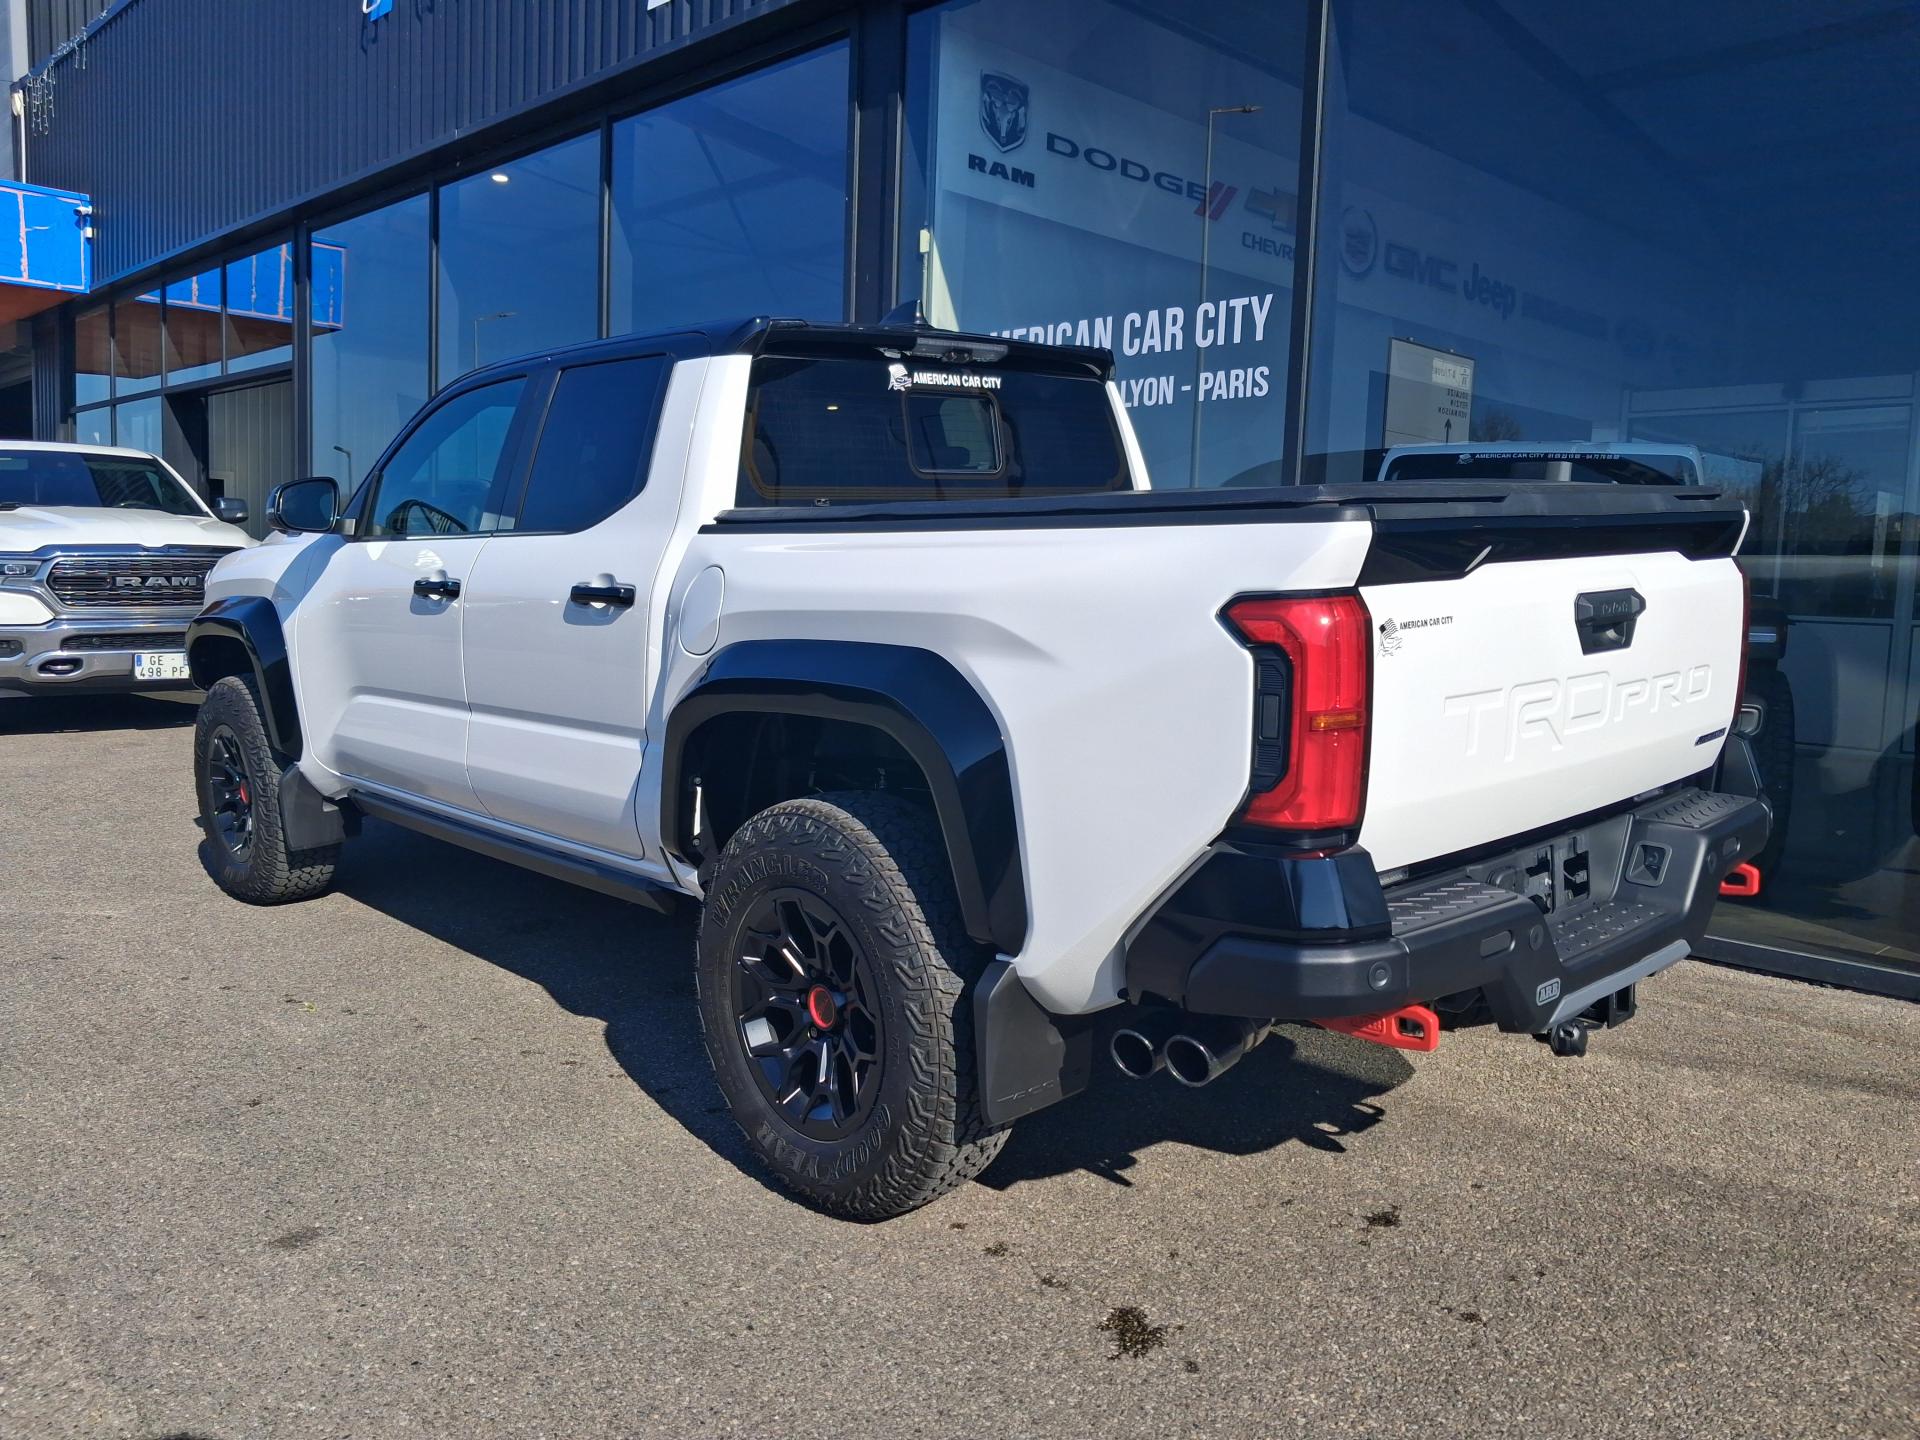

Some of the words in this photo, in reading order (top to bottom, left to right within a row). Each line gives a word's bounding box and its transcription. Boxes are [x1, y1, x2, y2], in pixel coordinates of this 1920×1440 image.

[967, 153, 1036, 189] RAM
[1046, 132, 1209, 201] DODGE
[1241, 231, 1296, 262] CHEVR
[1463, 262, 1517, 320] Jeep
[1122, 306, 1185, 357] CAR
[1194, 293, 1274, 349] CITY
[913, 371, 961, 387] AMERICAN
[961, 375, 981, 388] CAR
[981, 376, 1001, 389] CITY
[1121, 375, 1175, 408] LYON
[1197, 365, 1271, 403] PARIS
[115, 576, 197, 587] RAM
[1400, 620, 1428, 630] AMERICAN
[1429, 617, 1441, 626] CAR
[1441, 616, 1454, 625] CITY
[150, 655, 164, 666] GE
[1444, 670, 1611, 763] TRD
[1614, 664, 1711, 723] PRO
[713, 854, 830, 929] WRANGLER
